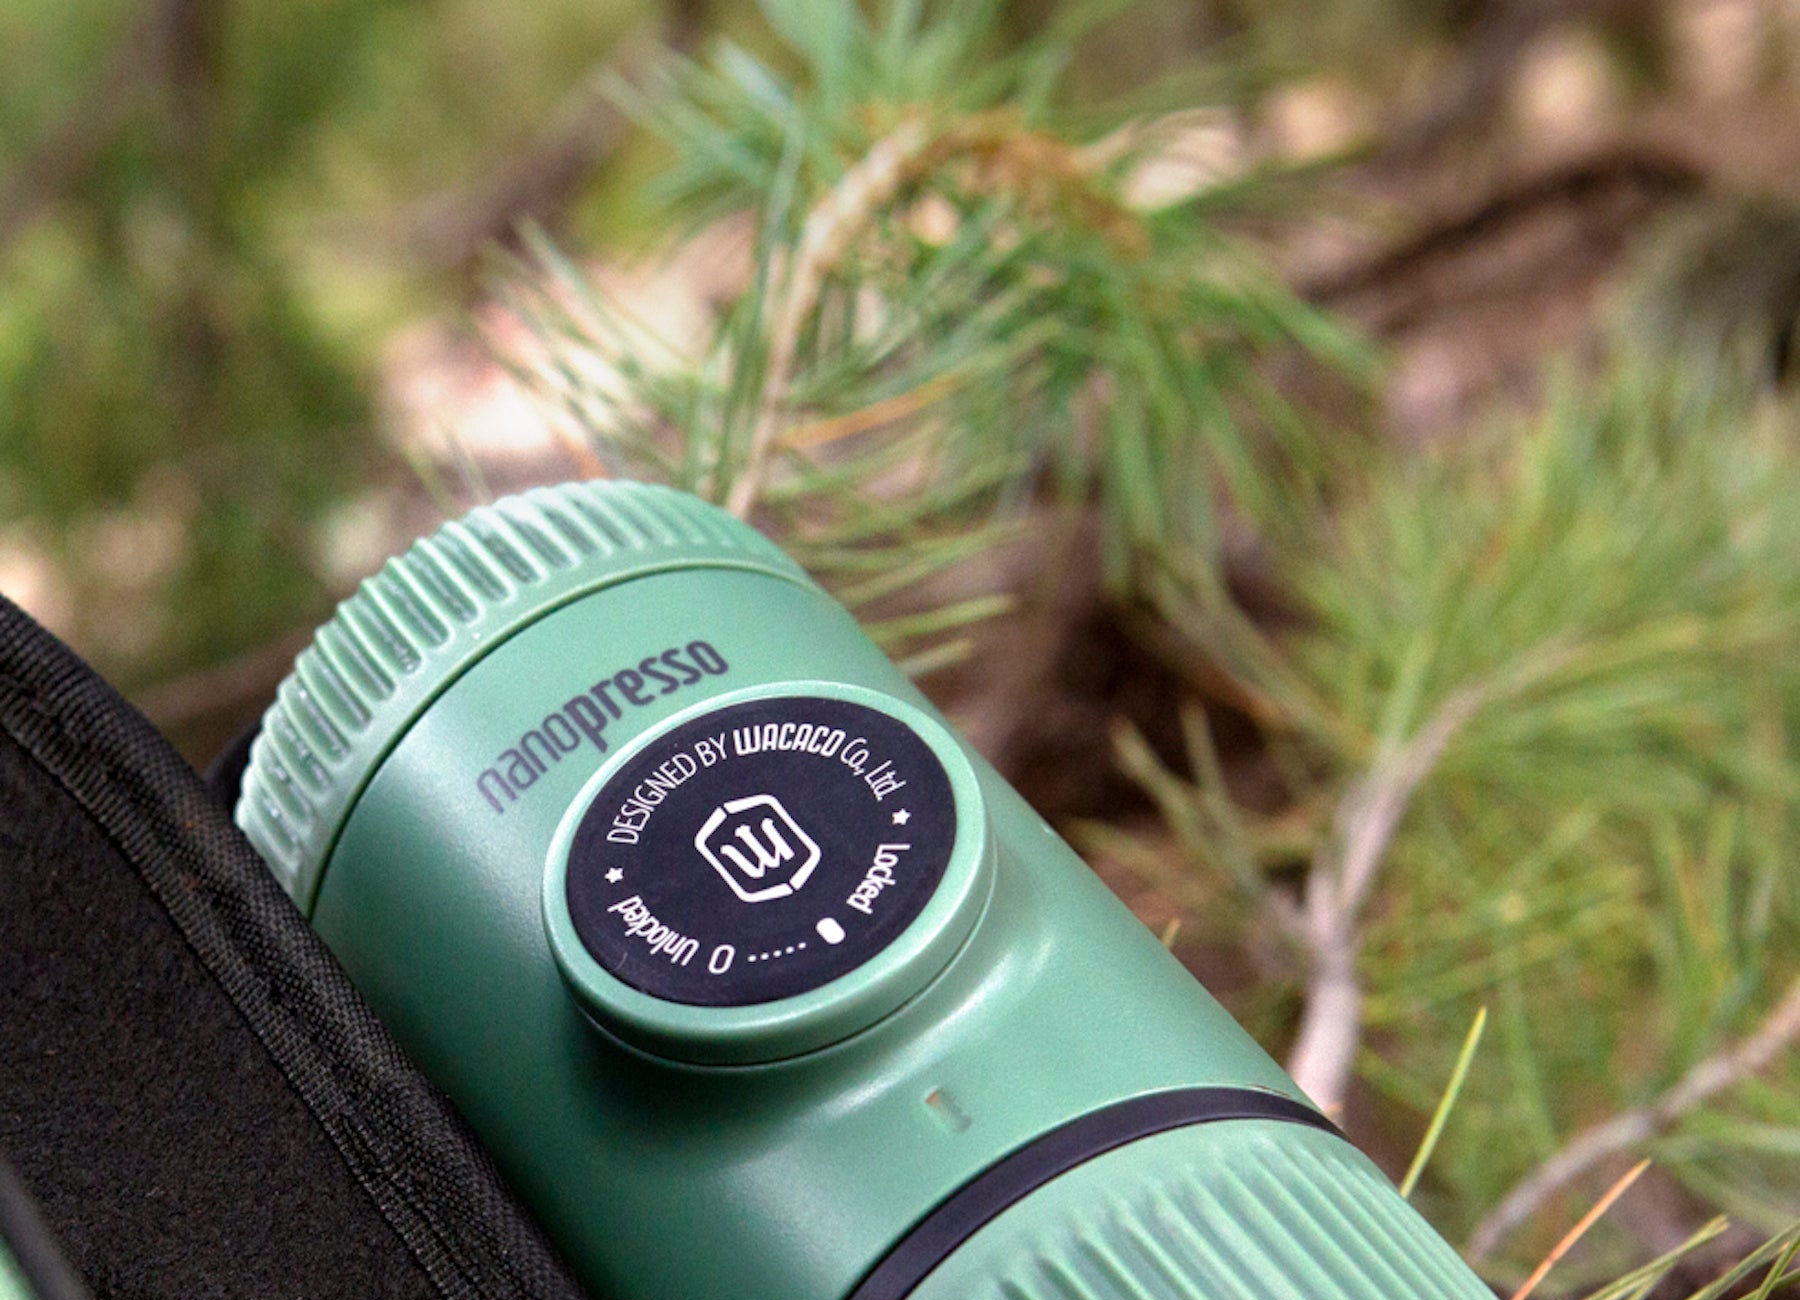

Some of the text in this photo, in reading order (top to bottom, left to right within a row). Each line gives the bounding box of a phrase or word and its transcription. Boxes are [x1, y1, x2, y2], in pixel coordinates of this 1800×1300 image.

[477, 640, 729, 814] nanopresso
[606, 752, 697, 845] DESIGNED
[694, 733, 728, 768] BY
[732, 722, 847, 758] WACACO
[845, 843, 911, 915] Locked
[606, 894, 700, 966] Unlocked
